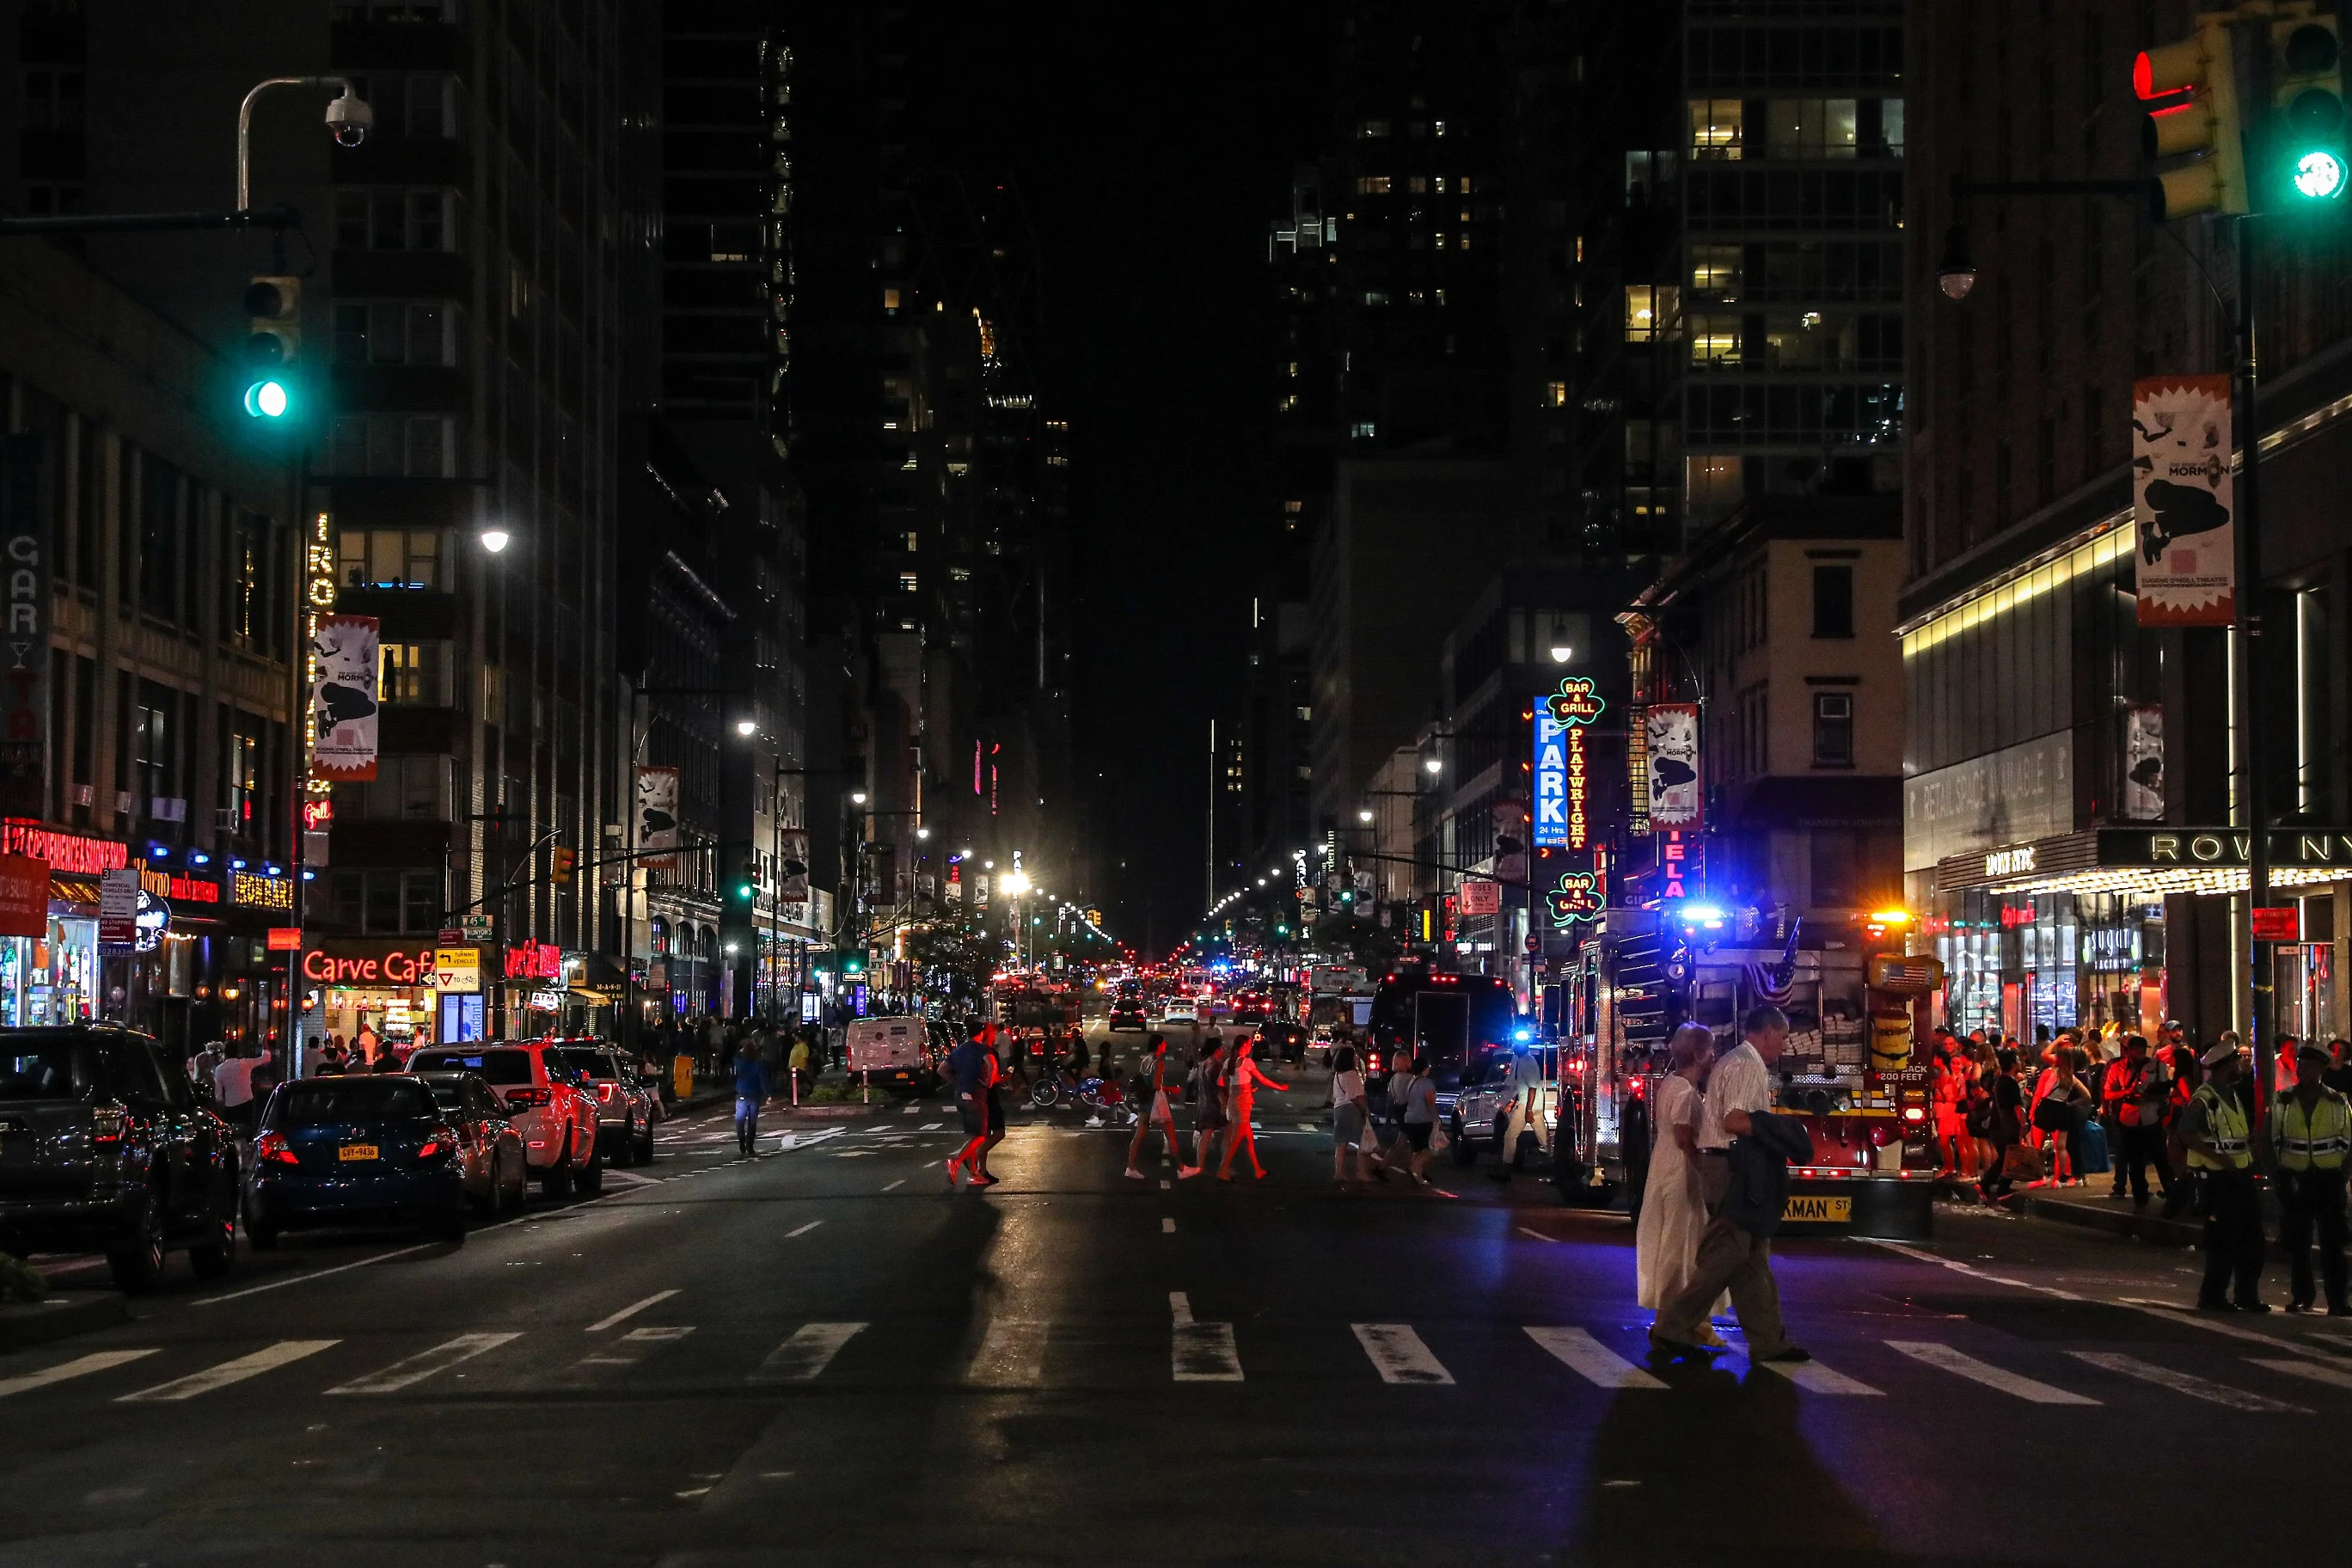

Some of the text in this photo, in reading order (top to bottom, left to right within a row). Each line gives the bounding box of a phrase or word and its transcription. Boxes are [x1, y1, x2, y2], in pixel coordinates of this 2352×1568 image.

[2169, 465, 2230, 476] MORMON
[1565, 683, 1589, 693] BAR
[1573, 693, 1581, 702] &
[1560, 703, 1595, 713] GRILL
[1540, 719, 1565, 824] PARK
[1570, 728, 1586, 848] PLAYWRIGHT
[305, 800, 332, 830] Grill
[110, 841, 128, 870] SHOP
[1985, 846, 2037, 877] ROW NYC
[103, 870, 110, 879] 3
[140, 858, 170, 897] forno
[1565, 879, 1589, 889] BAR
[1572, 889, 1581, 899] &
[462, 917, 469, 926] W
[469, 916, 478, 926] 45
[2091, 928, 2128, 958] sugar
[303, 950, 436, 983] Carve Caf
[534, 994, 554, 1003] ATM
[1835, 1200, 1847, 1210] ST
